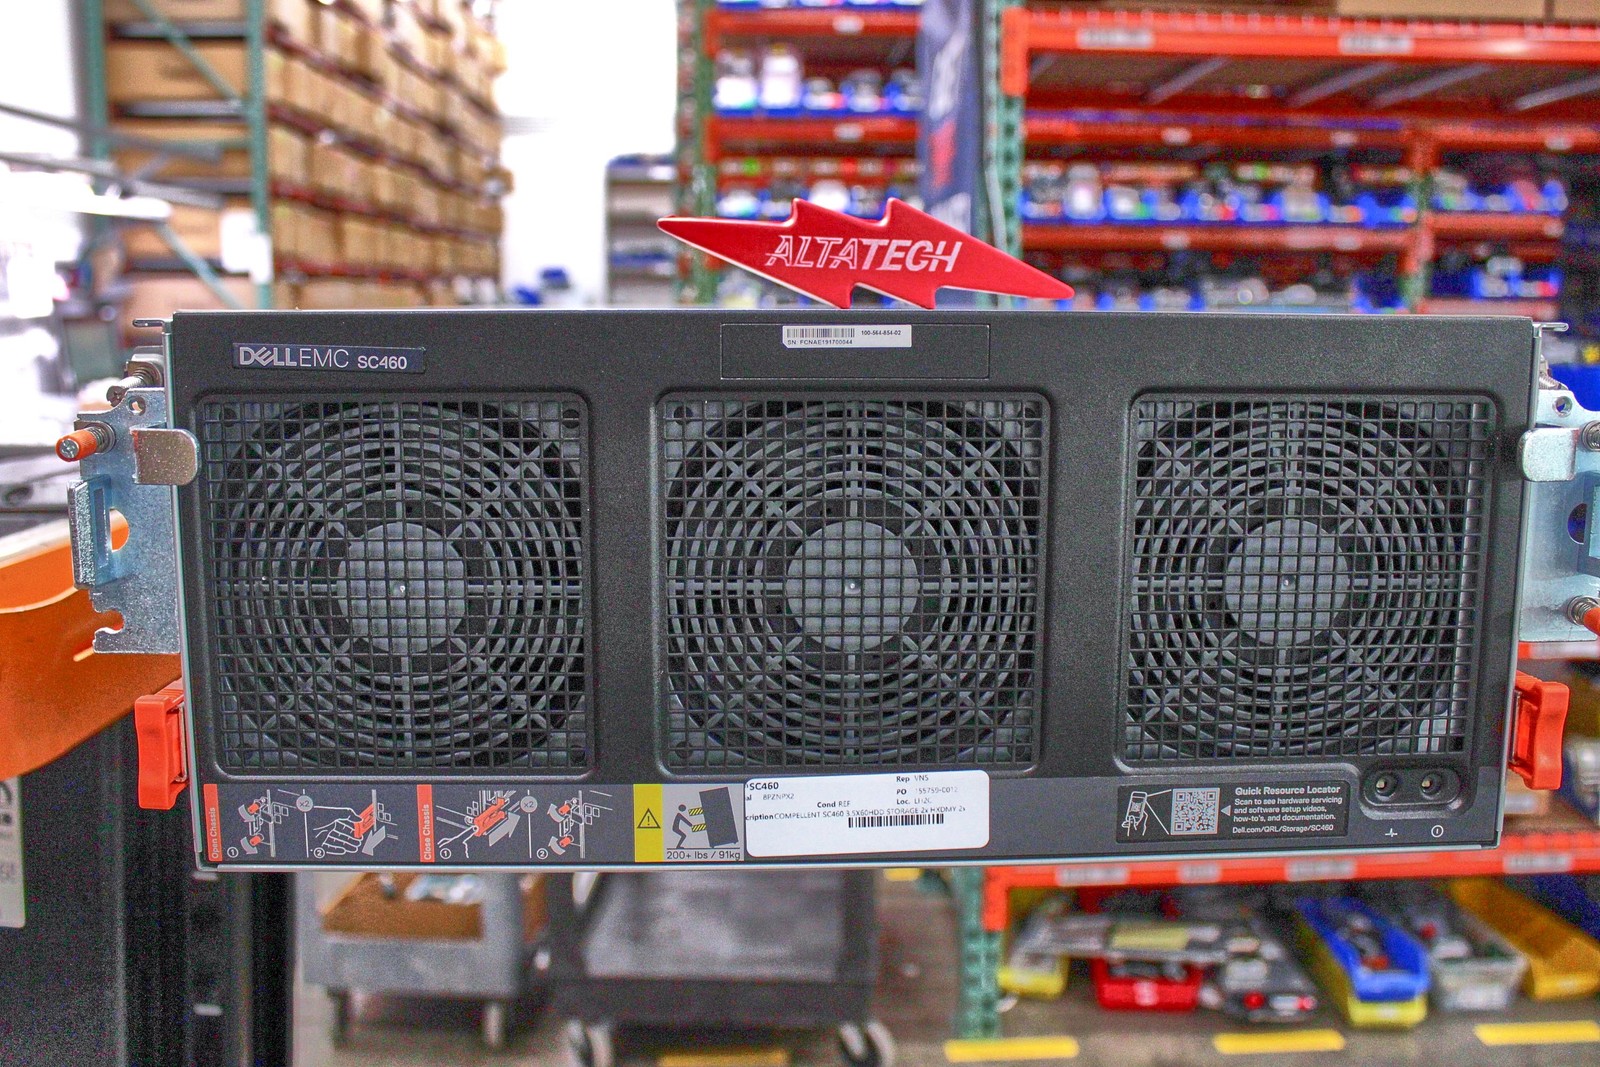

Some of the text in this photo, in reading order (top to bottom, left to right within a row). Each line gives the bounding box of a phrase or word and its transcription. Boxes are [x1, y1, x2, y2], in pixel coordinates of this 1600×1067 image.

[765, 234, 962, 272] ALTATECH
[357, 355, 407, 369] SC460
[896, 775, 910, 783] Rep
[749, 782, 779, 791] SC460
[1235, 786, 1341, 796] Quick Resource Locator
[838, 800, 850, 808] REF
[1277, 797, 1310, 805] hardware
[1311, 796, 1343, 805] servicing
[774, 811, 821, 820] COMPELLENT
[823, 810, 844, 818] SC460
[886, 807, 919, 815] STORAGE
[1249, 806, 1280, 814] software
[1281, 806, 1302, 814] setup
[1302, 805, 1327, 813] videos,
[1282, 813, 1336, 821] documentation.
[209, 807, 220, 859] Open Chassis
[422, 804, 432, 860] Close Chassis
[1232, 824, 1334, 834] Dell.com/QRL/Storage/SC460
[666, 851, 691, 859] 200+
[694, 851, 708, 859] lbs
[718, 851, 741, 861] 91kg
